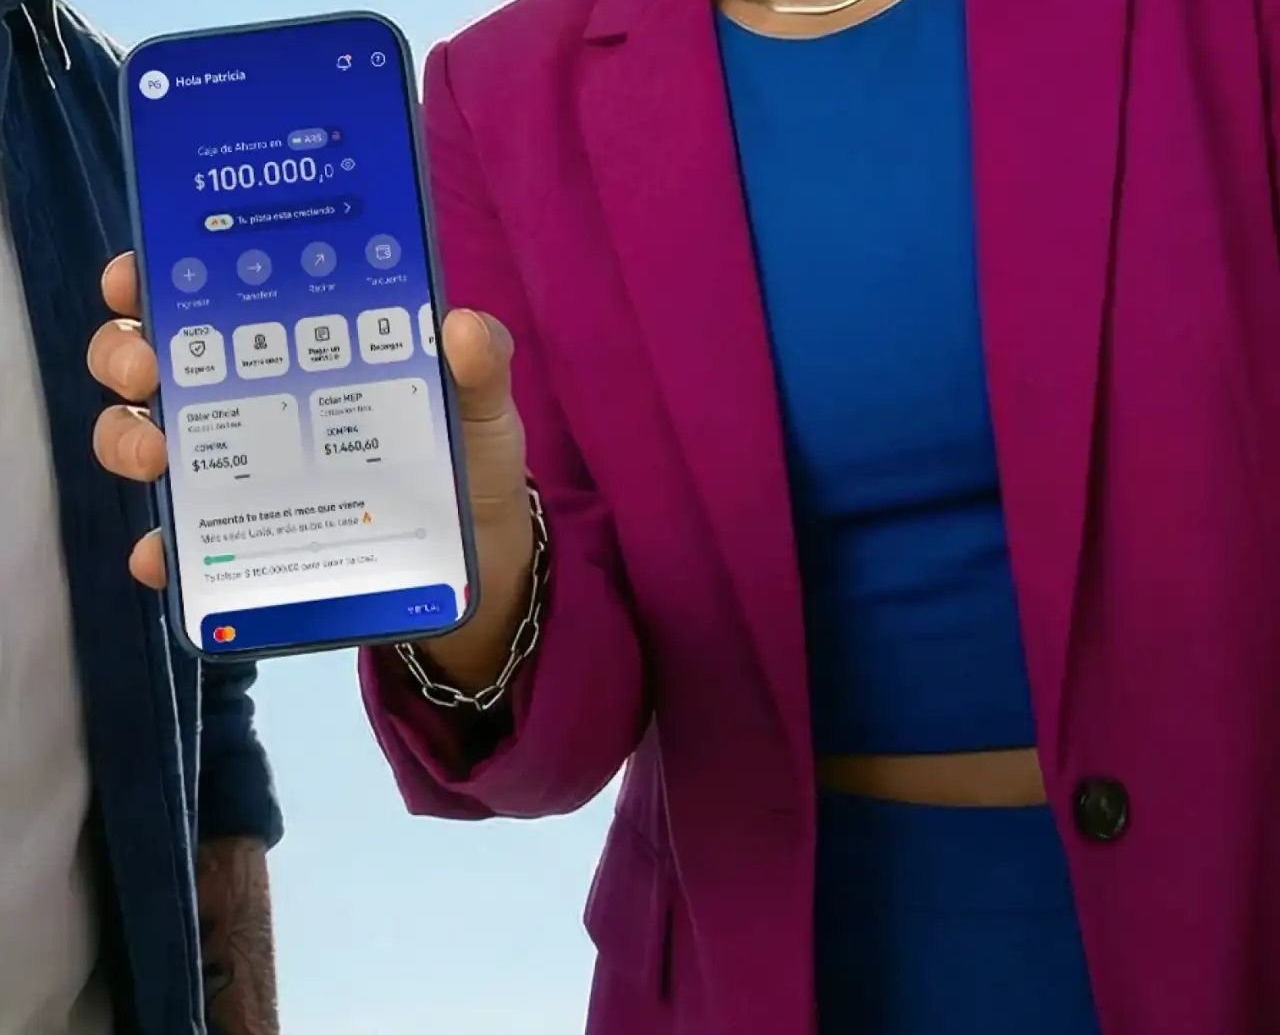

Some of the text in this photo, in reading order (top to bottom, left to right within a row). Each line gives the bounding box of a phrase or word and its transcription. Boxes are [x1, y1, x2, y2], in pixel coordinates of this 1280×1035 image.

[175, 69, 246, 87] Hola Patricia
[197, 145, 218, 157] Caja
[220, 144, 233, 153] de
[235, 141, 268, 151] Ahorro
[270, 139, 283, 148] en
[250, 214, 272, 225] plata
[293, 206, 336, 218] creciendo
[324, 437, 379, 455] $1.460,60
[192, 454, 248, 473] $1.465,00
[317, 504, 336, 514] que
[338, 500, 365, 510] viene
